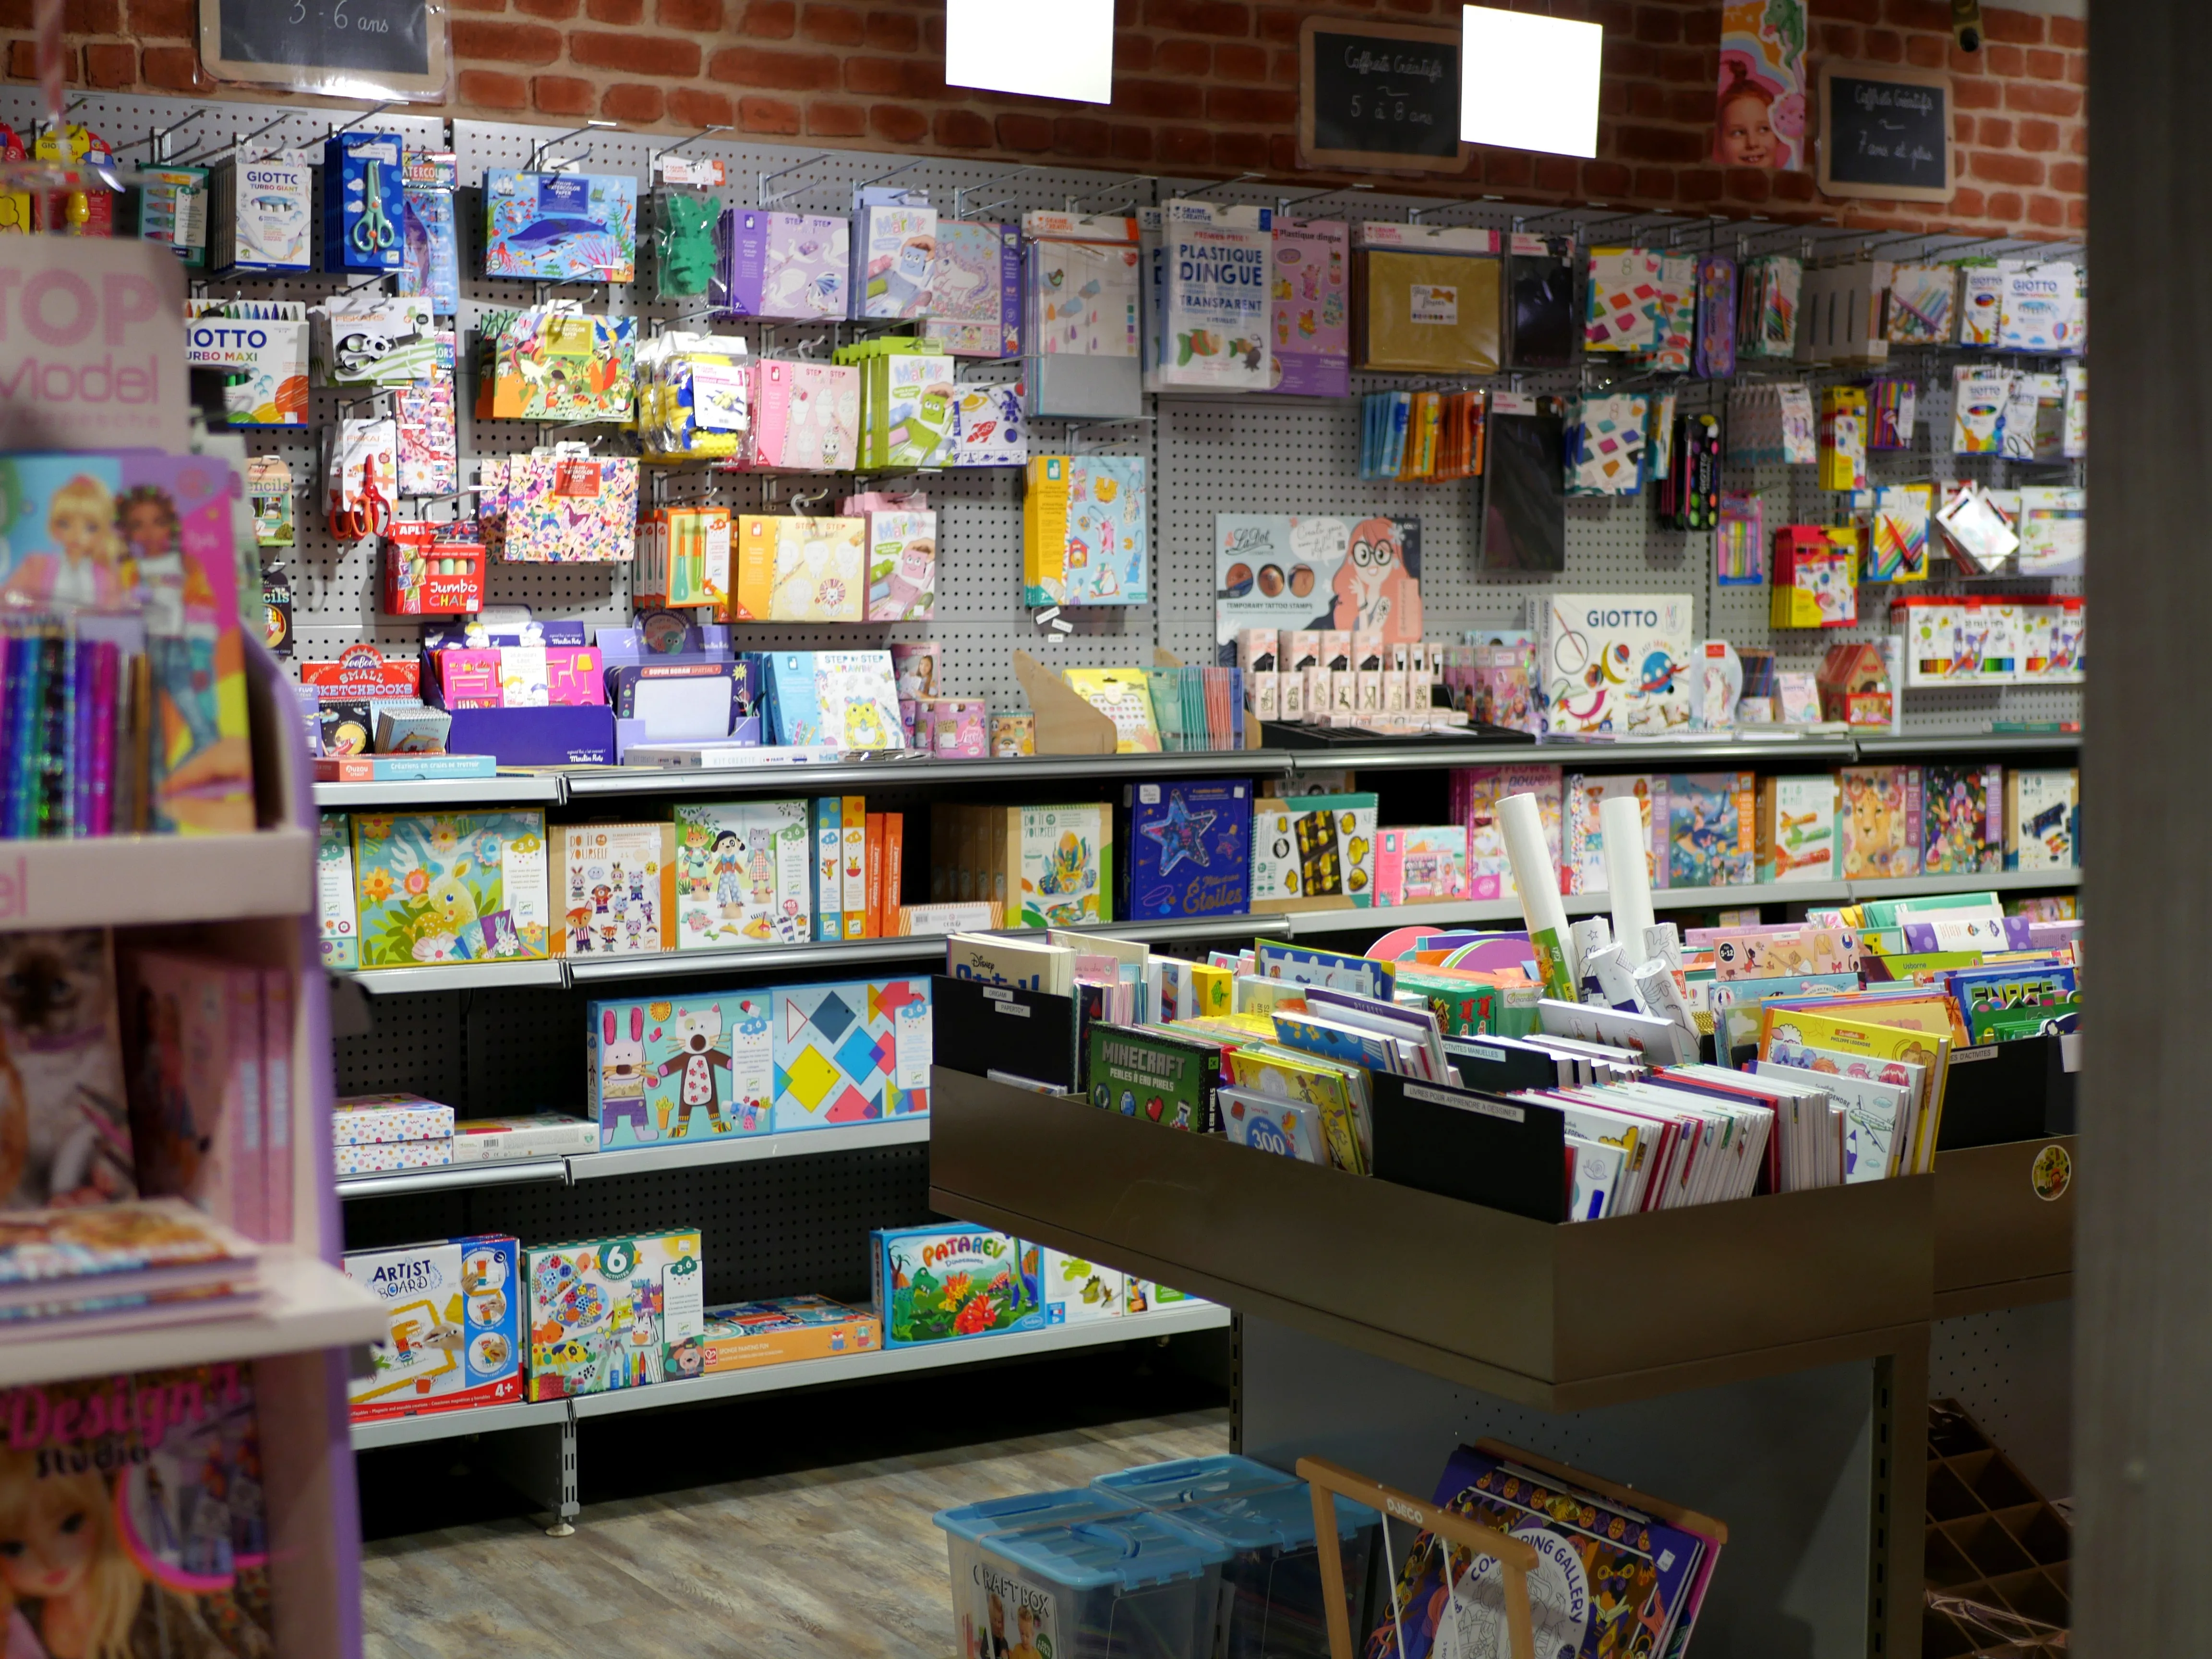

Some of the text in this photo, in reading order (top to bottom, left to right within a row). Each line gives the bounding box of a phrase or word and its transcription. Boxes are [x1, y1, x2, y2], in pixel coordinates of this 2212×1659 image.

[334, 0, 348, 28] 6
[358, 15, 389, 33] ans
[1350, 95, 1362, 117] 5
[1394, 101, 1405, 121] 8
[1279, 228, 1342, 243] Plastique dingue
[1180, 244, 1262, 264] PLASTIQUE
[1179, 262, 1262, 286] DINGUE
[2012, 279, 2057, 292] GIOTTO
[1180, 294, 1262, 311] TRANSPARENT
[335, 314, 385, 323] FISKARS
[186, 328, 267, 349] IOTTO
[186, 352, 258, 362] URBO MAXI
[248, 479, 289, 492] encils
[430, 581, 478, 594] Jumbo
[263, 589, 289, 603] cils
[1587, 611, 1657, 627] GIOTTO
[825, 655, 848, 664] STEP
[861, 655, 884, 664] STEP
[339, 670, 384, 684] SMALL
[314, 684, 413, 697] SKETCHBOOKS
[569, 834, 582, 847] DO
[569, 847, 608, 860] YOURSELF
[988, 990, 1007, 999] ORIGAMI
[1000, 1004, 1024, 1014] PAPERTOY
[1830, 1036, 1871, 1048] PHILIPPE LEGENDRE
[1102, 1040, 1186, 1079] MINECRAFT
[1468, 1046, 1498, 1058] MANUELLES
[1960, 1049, 1991, 1060] D'ACTIVITES
[1110, 1069, 1131, 1083] PERLES
[1139, 1075, 1151, 1086] EAU
[1152, 1077, 1174, 1093] PIXELS
[1409, 1087, 1427, 1098] LIVRES
[1429, 1090, 1445, 1102] POUR
[1446, 1094, 1479, 1109] APPRENDRE
[1487, 1102, 1517, 1118] DESSINER
[1828, 1094, 1851, 1108] GENDRE
[1251, 1129, 1286, 1155] 300
[607, 1245, 627, 1274] 6
[945, 1257, 984, 1266] Dinosaures
[372, 1259, 431, 1283] ARTIST
[379, 1275, 428, 1299] BOARD
[495, 1382, 513, 1398] 4+
[1386, 1498, 1423, 1524] DJECO
[1471, 1536, 1583, 1624] COLING GALLERY
[1021, 1588, 1050, 1618] BOX
